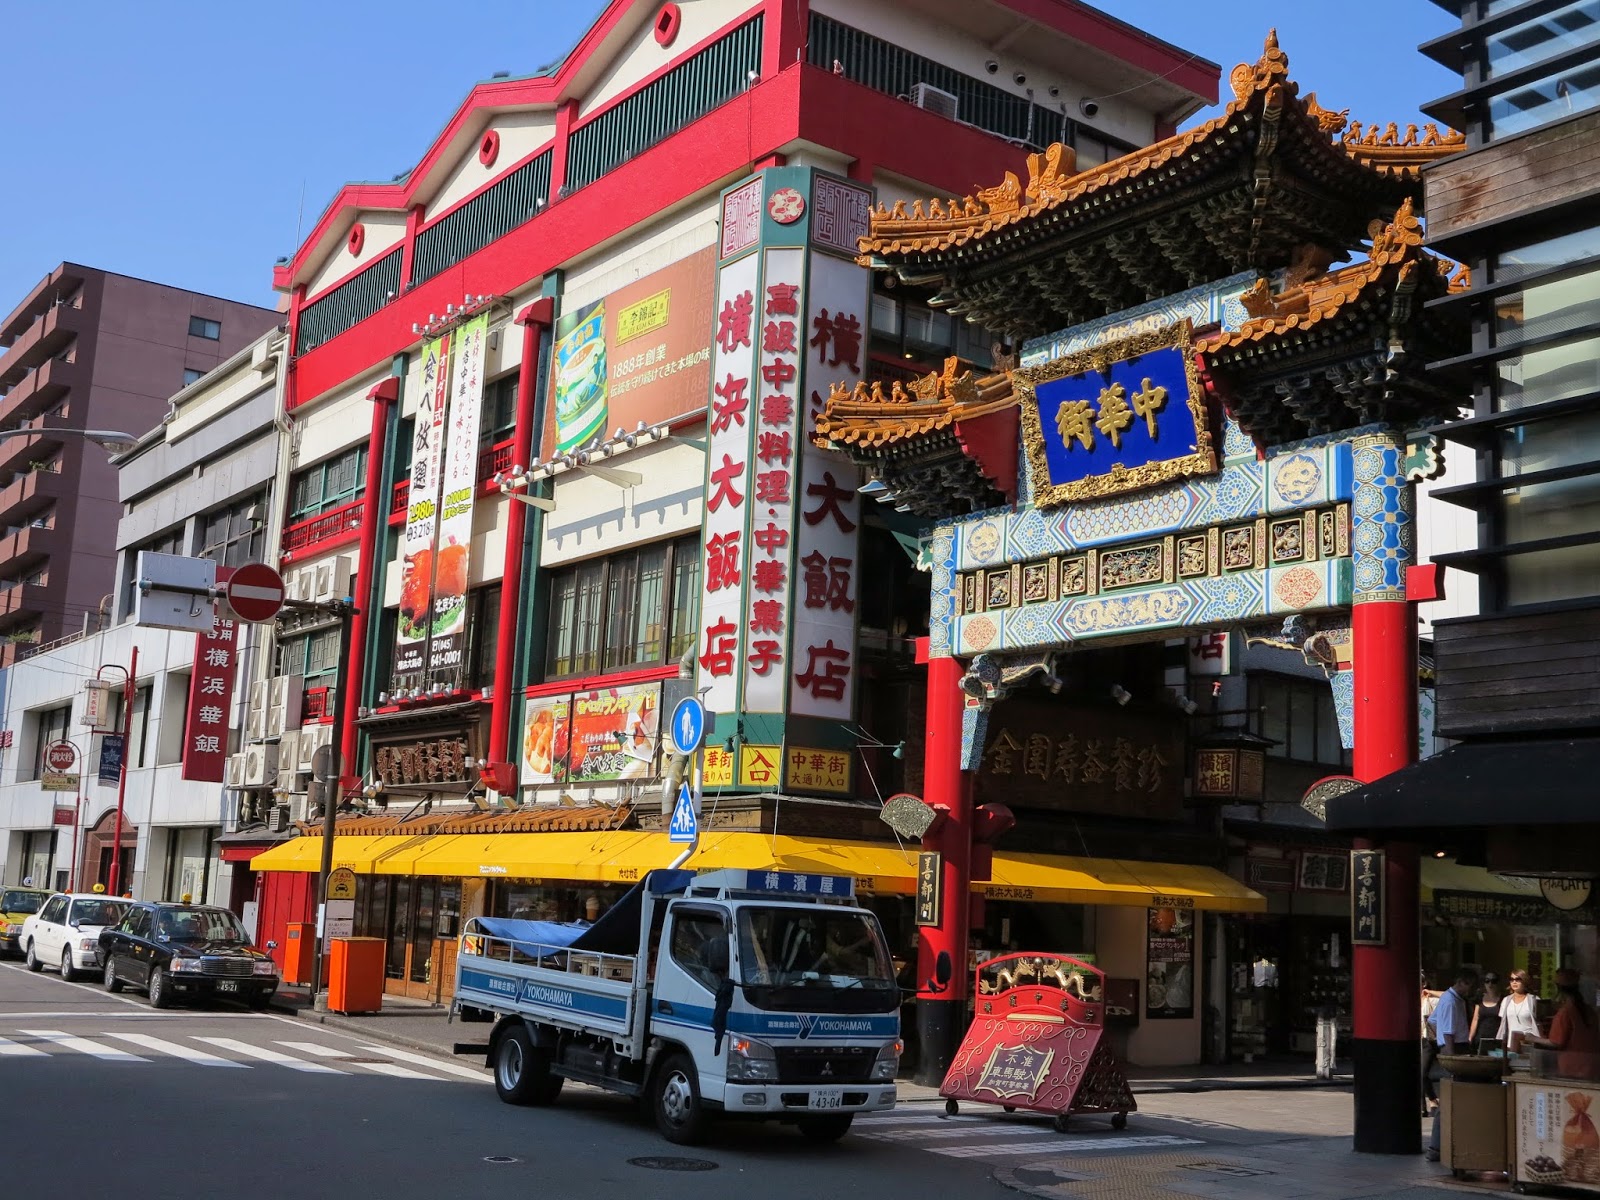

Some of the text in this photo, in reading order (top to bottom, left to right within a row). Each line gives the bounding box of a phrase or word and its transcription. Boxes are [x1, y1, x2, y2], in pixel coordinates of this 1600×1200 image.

[631, 301, 657, 325] 李錦記
[610, 346, 710, 398] 伝統を守り続けてきた本場の味
[613, 344, 667, 379] 1888年創業
[433, 354, 448, 423] オーダー式
[413, 350, 437, 491] 食べ放題
[1055, 377, 1167, 451] 中華街
[700, 289, 753, 681] 横浜大飯店
[749, 282, 800, 676] 高級中華料理・中華菓子
[795, 307, 863, 701] 横大飯店
[194, 647, 230, 754] 横浜華銀
[51, 751, 73, 763] 消火栓
[702, 750, 732, 769] 華街
[748, 749, 774, 782] 入口
[791, 751, 846, 775] 中華街
[791, 772, 845, 787] 大通り入口
[765, 872, 834, 894] 横濱屋
[527, 984, 573, 1006] YOKOHAMAYA
[819, 1020, 872, 1031] YOKOHAMAYA
[1005, 1053, 1034, 1067] 不准
[816, 1097, 841, 1108] 43-04
